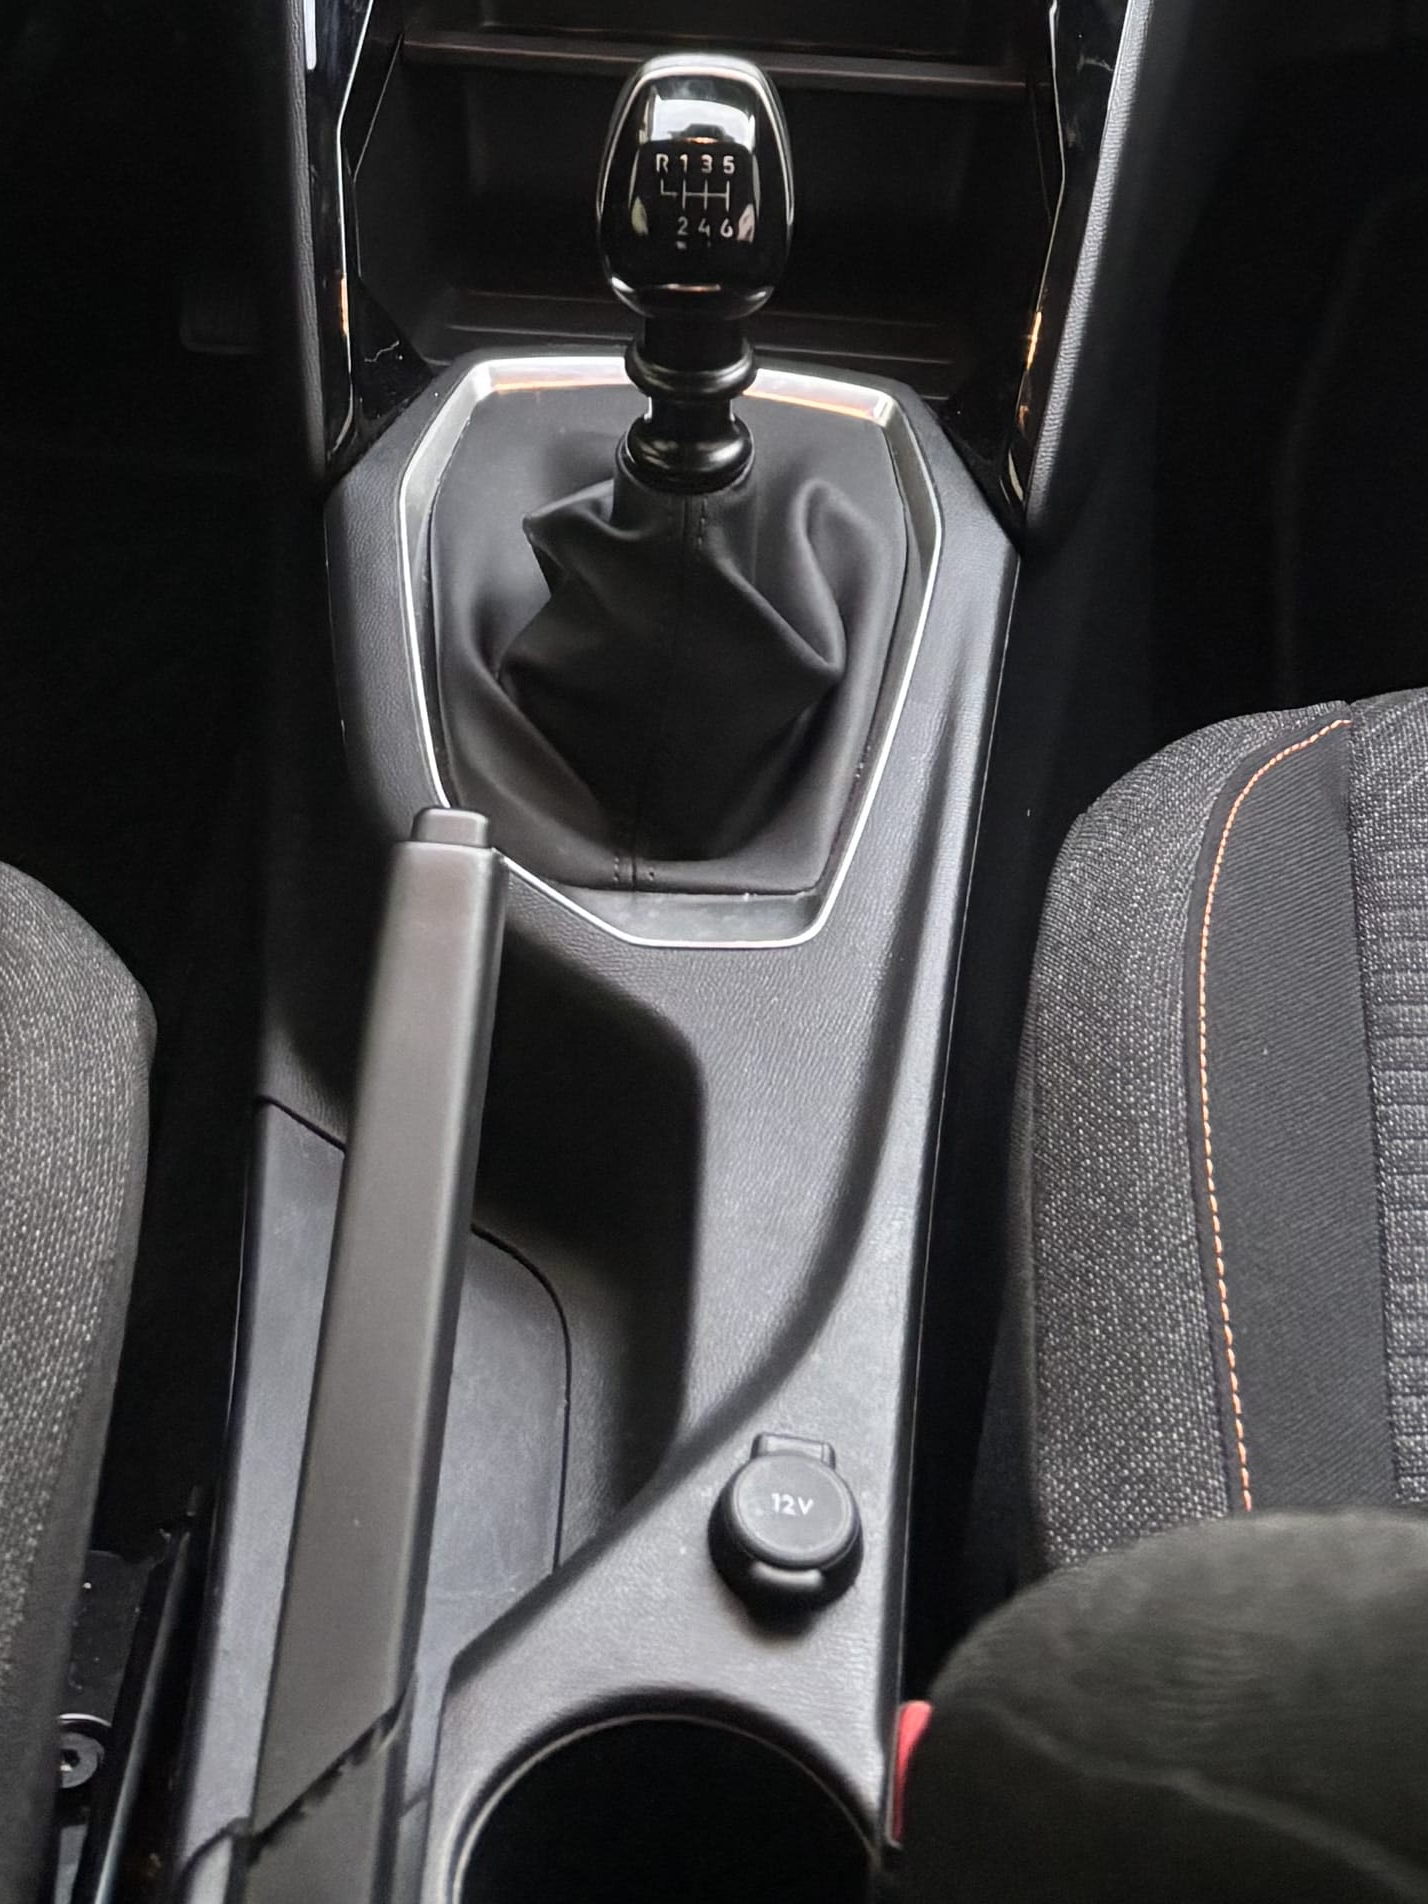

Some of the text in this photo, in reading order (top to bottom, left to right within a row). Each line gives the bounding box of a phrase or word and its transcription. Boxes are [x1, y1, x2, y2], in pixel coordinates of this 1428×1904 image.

[656, 153, 735, 174] R 1 3 5
[677, 216, 734, 238] 2 4 6
[771, 1492, 814, 1515] 12V
